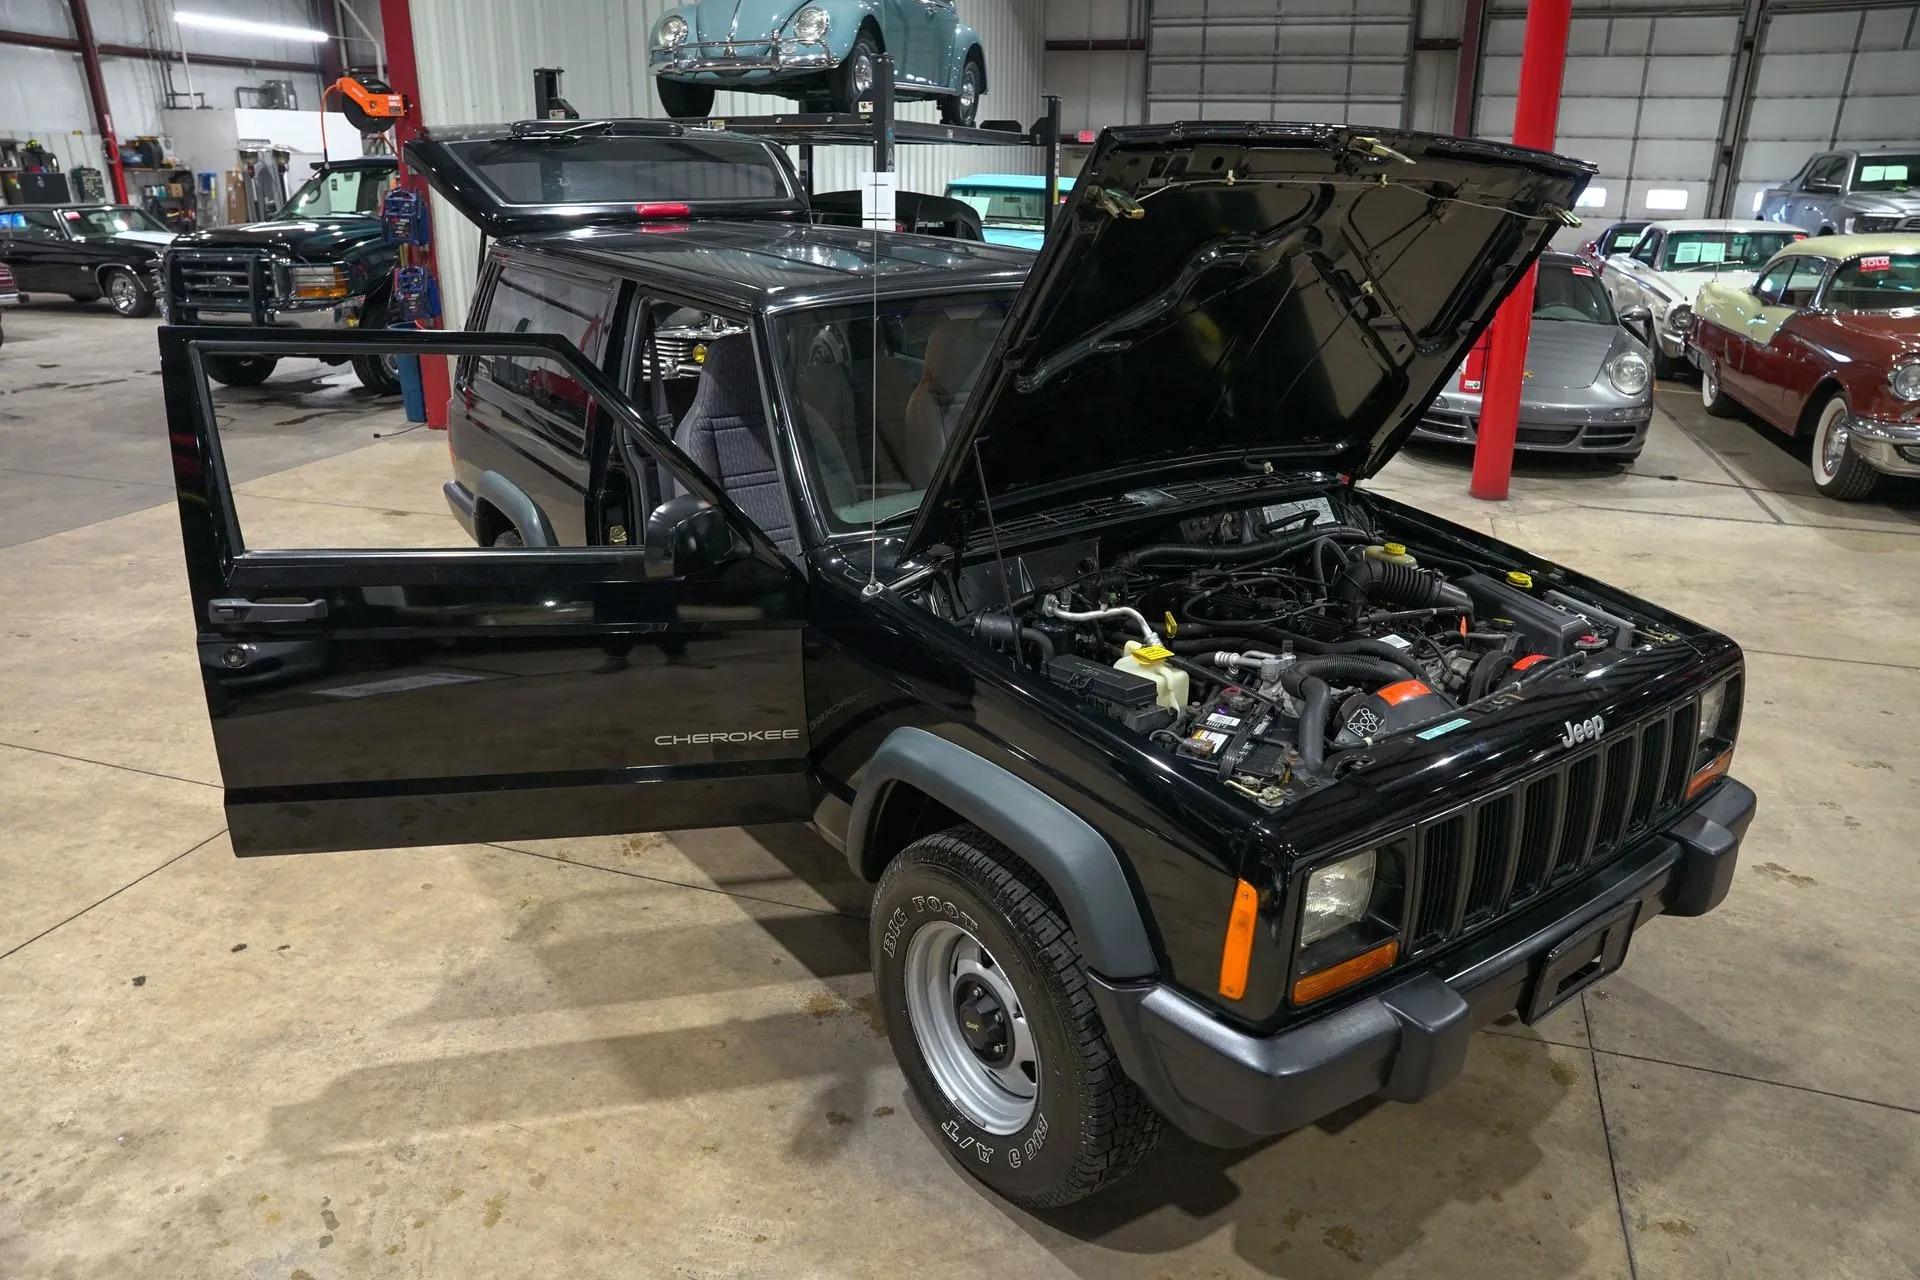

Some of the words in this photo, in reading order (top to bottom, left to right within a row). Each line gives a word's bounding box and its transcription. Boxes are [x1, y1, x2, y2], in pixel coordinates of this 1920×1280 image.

[1861, 259, 1889, 267] SOLD
[654, 729, 800, 746] CHEROKEE
[1562, 715, 1604, 748] Jeep
[883, 907, 908, 958] BIG
[912, 896, 978, 931] FOOT
[941, 1120, 994, 1164] A/T
[1024, 1112, 1049, 1161] BIG
